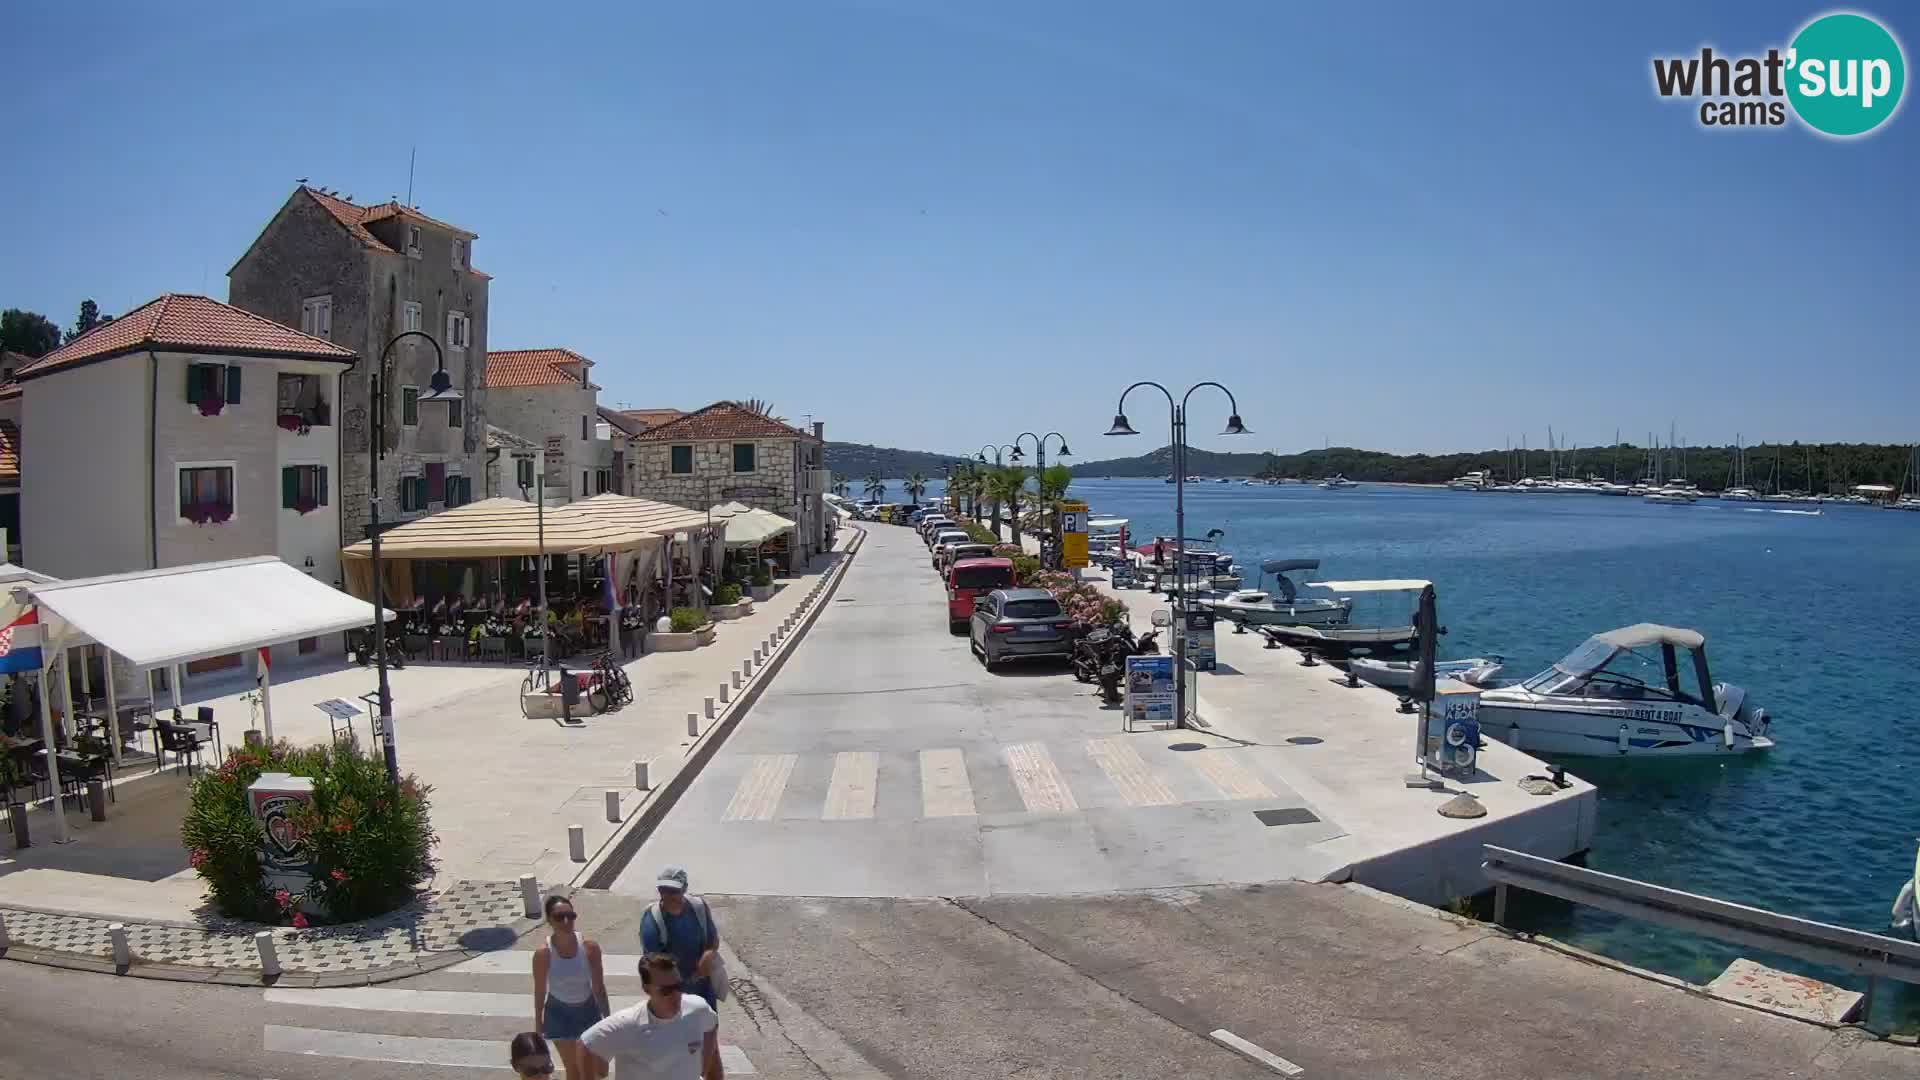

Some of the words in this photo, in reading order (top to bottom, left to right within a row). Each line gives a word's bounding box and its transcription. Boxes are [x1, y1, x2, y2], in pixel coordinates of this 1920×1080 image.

[1064, 514, 1075, 531] P
[1635, 709, 1656, 720] RENT
[1663, 710, 1683, 723] BOAT
